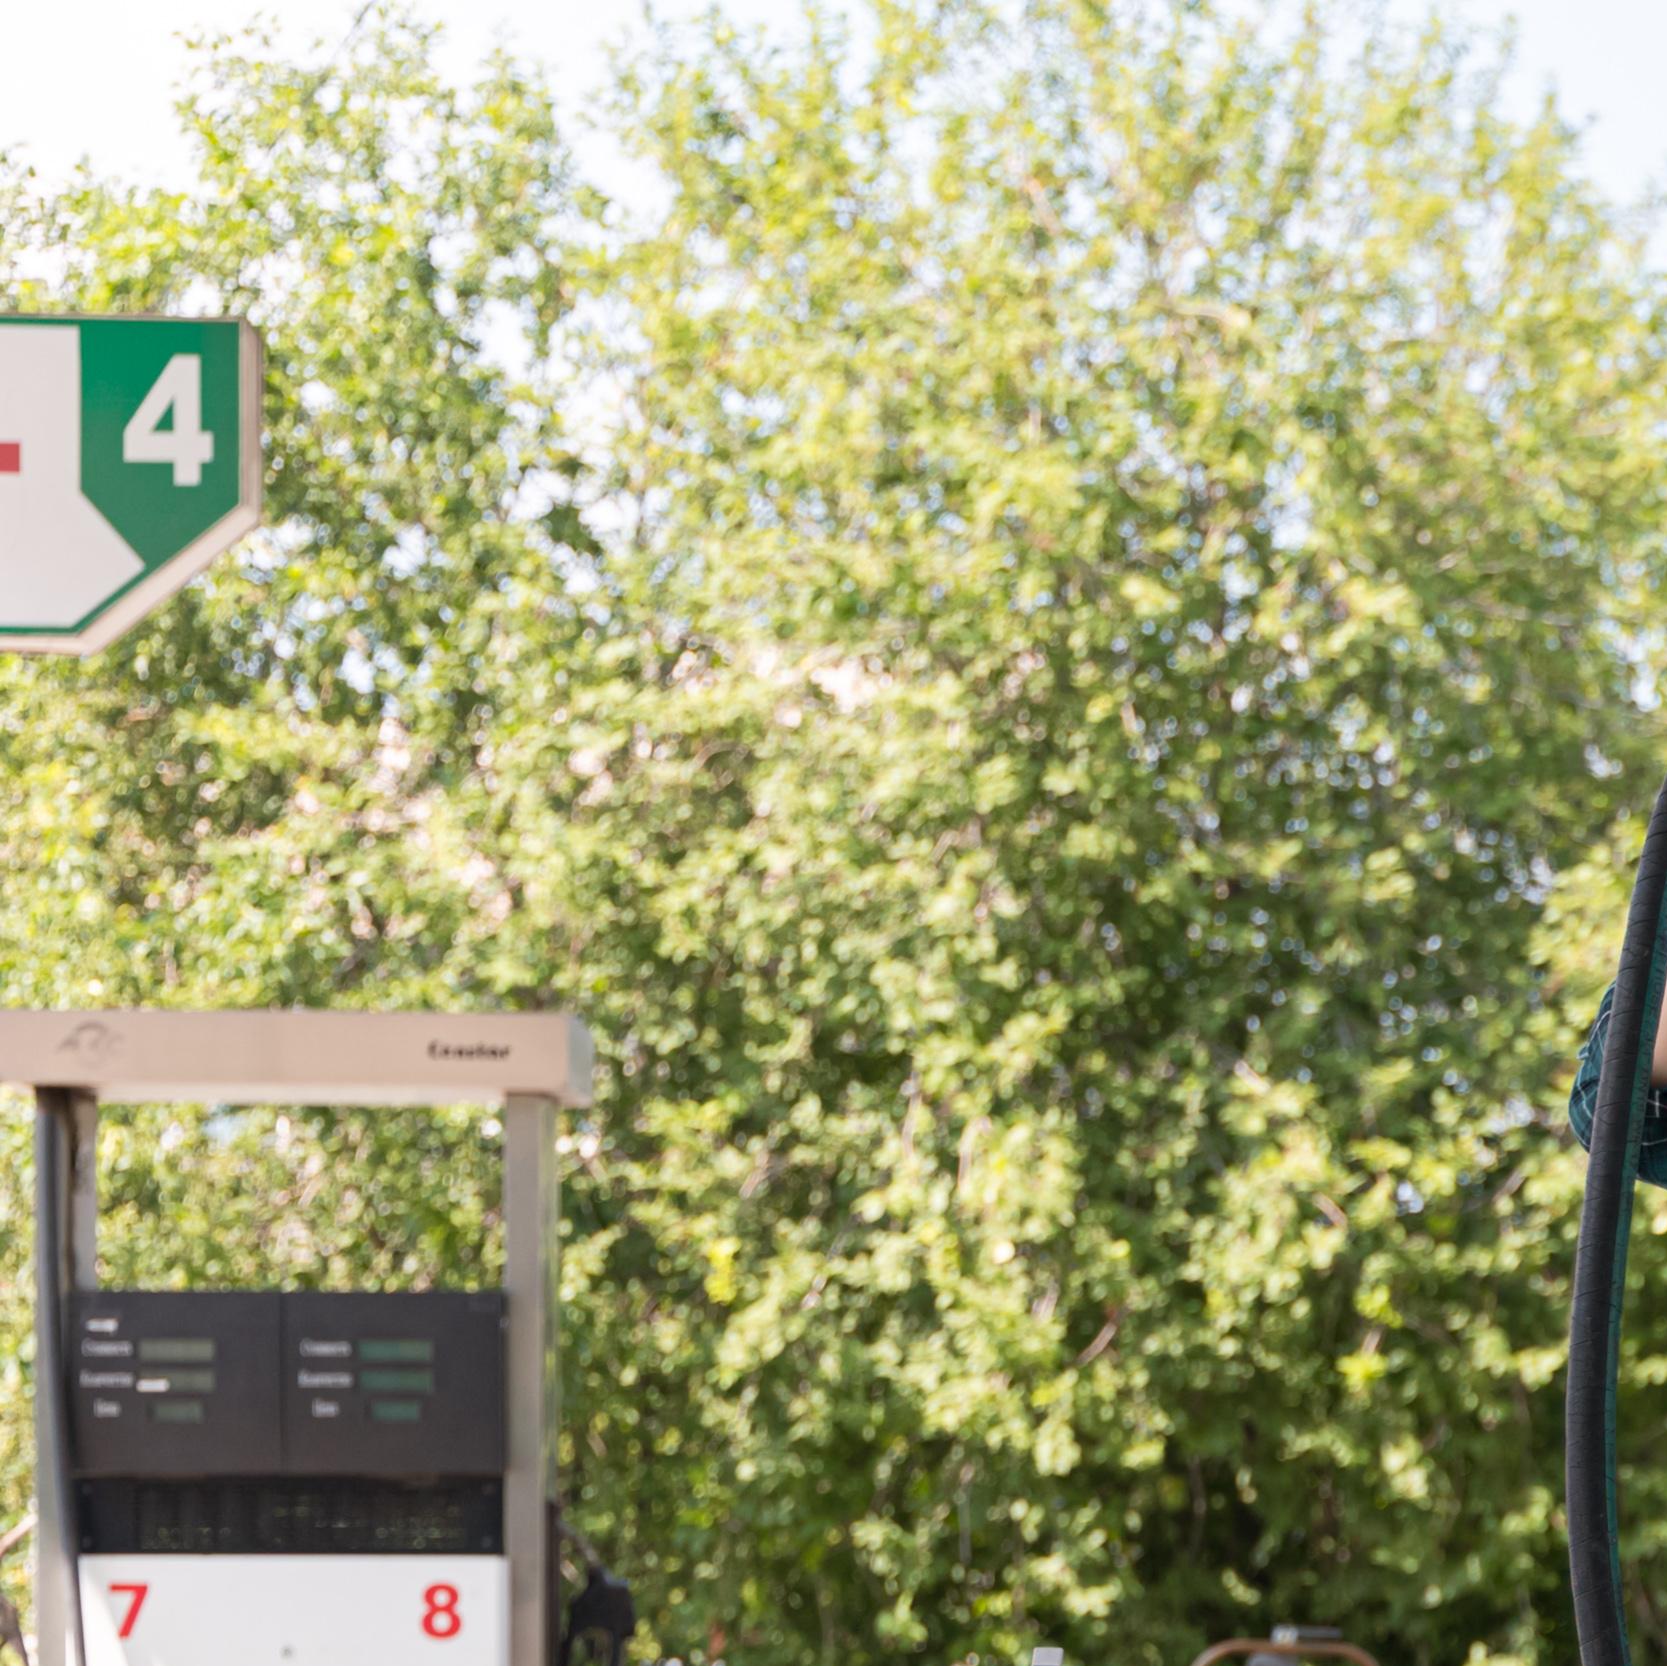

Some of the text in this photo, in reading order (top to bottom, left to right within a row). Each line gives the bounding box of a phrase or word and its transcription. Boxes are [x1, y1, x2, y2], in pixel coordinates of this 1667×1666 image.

[122, 353, 214, 487] 4
[109, 1583, 149, 1638] 7
[420, 1583, 462, 1639] 8
